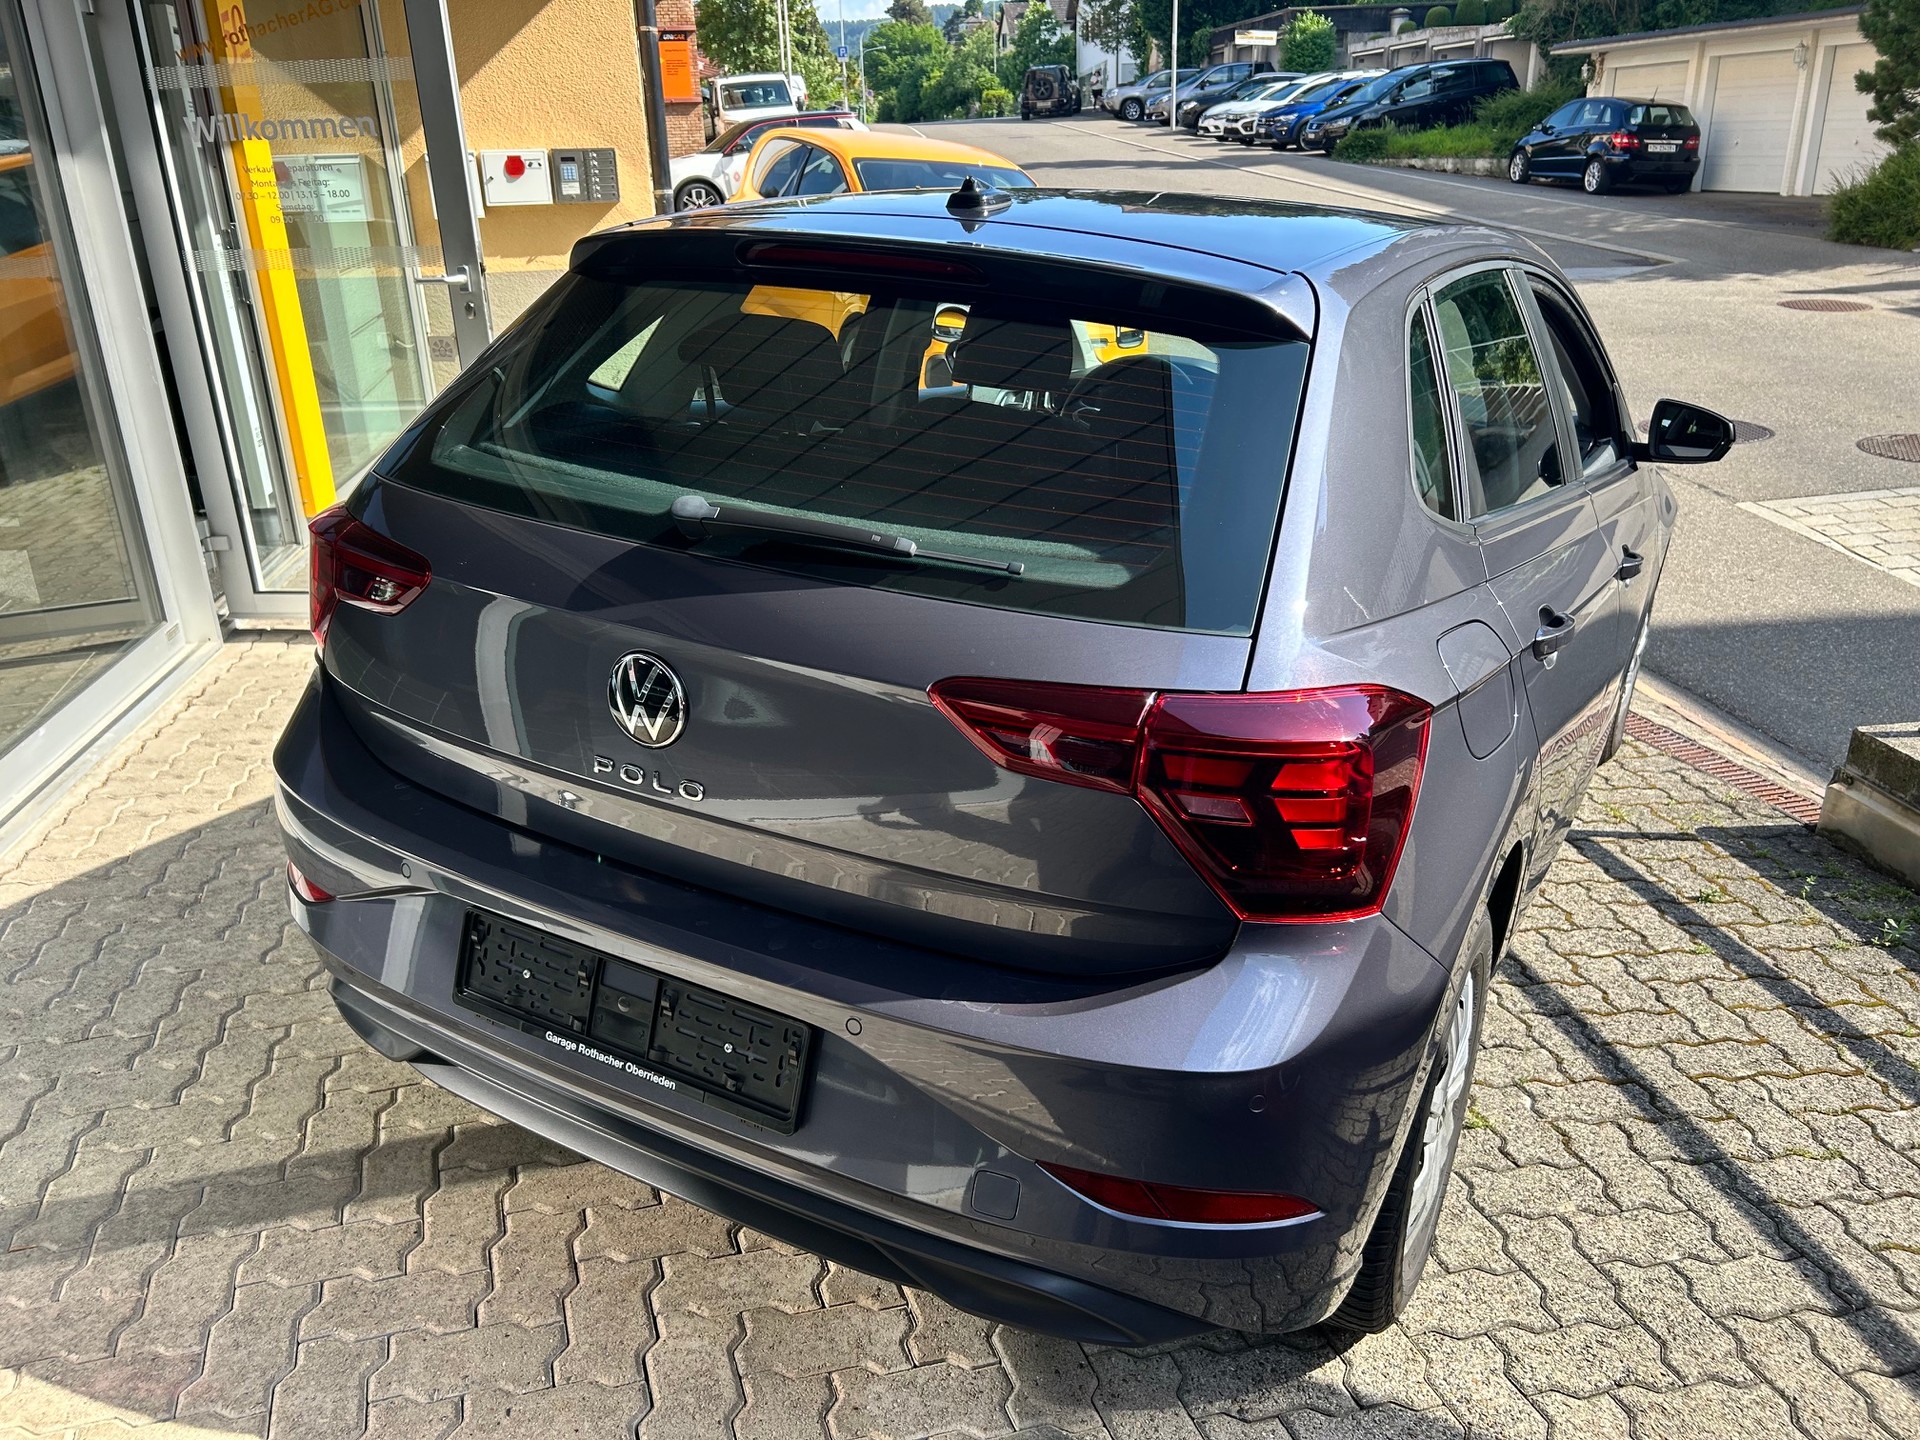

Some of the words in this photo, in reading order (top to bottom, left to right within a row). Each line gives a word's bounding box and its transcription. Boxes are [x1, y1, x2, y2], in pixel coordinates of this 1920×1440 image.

[183, 113, 378, 143] Willkommen
[286, 164, 334, 174] eparaturen
[251, 180, 283, 188] Monta
[296, 190, 318, 198] 13.15
[327, 189, 350, 198] 18.00
[594, 755, 705, 802] POLO
[545, 1031, 577, 1050] Garage
[578, 1043, 624, 1069] Rothacher
[625, 1062, 676, 1090] Oberrieden
